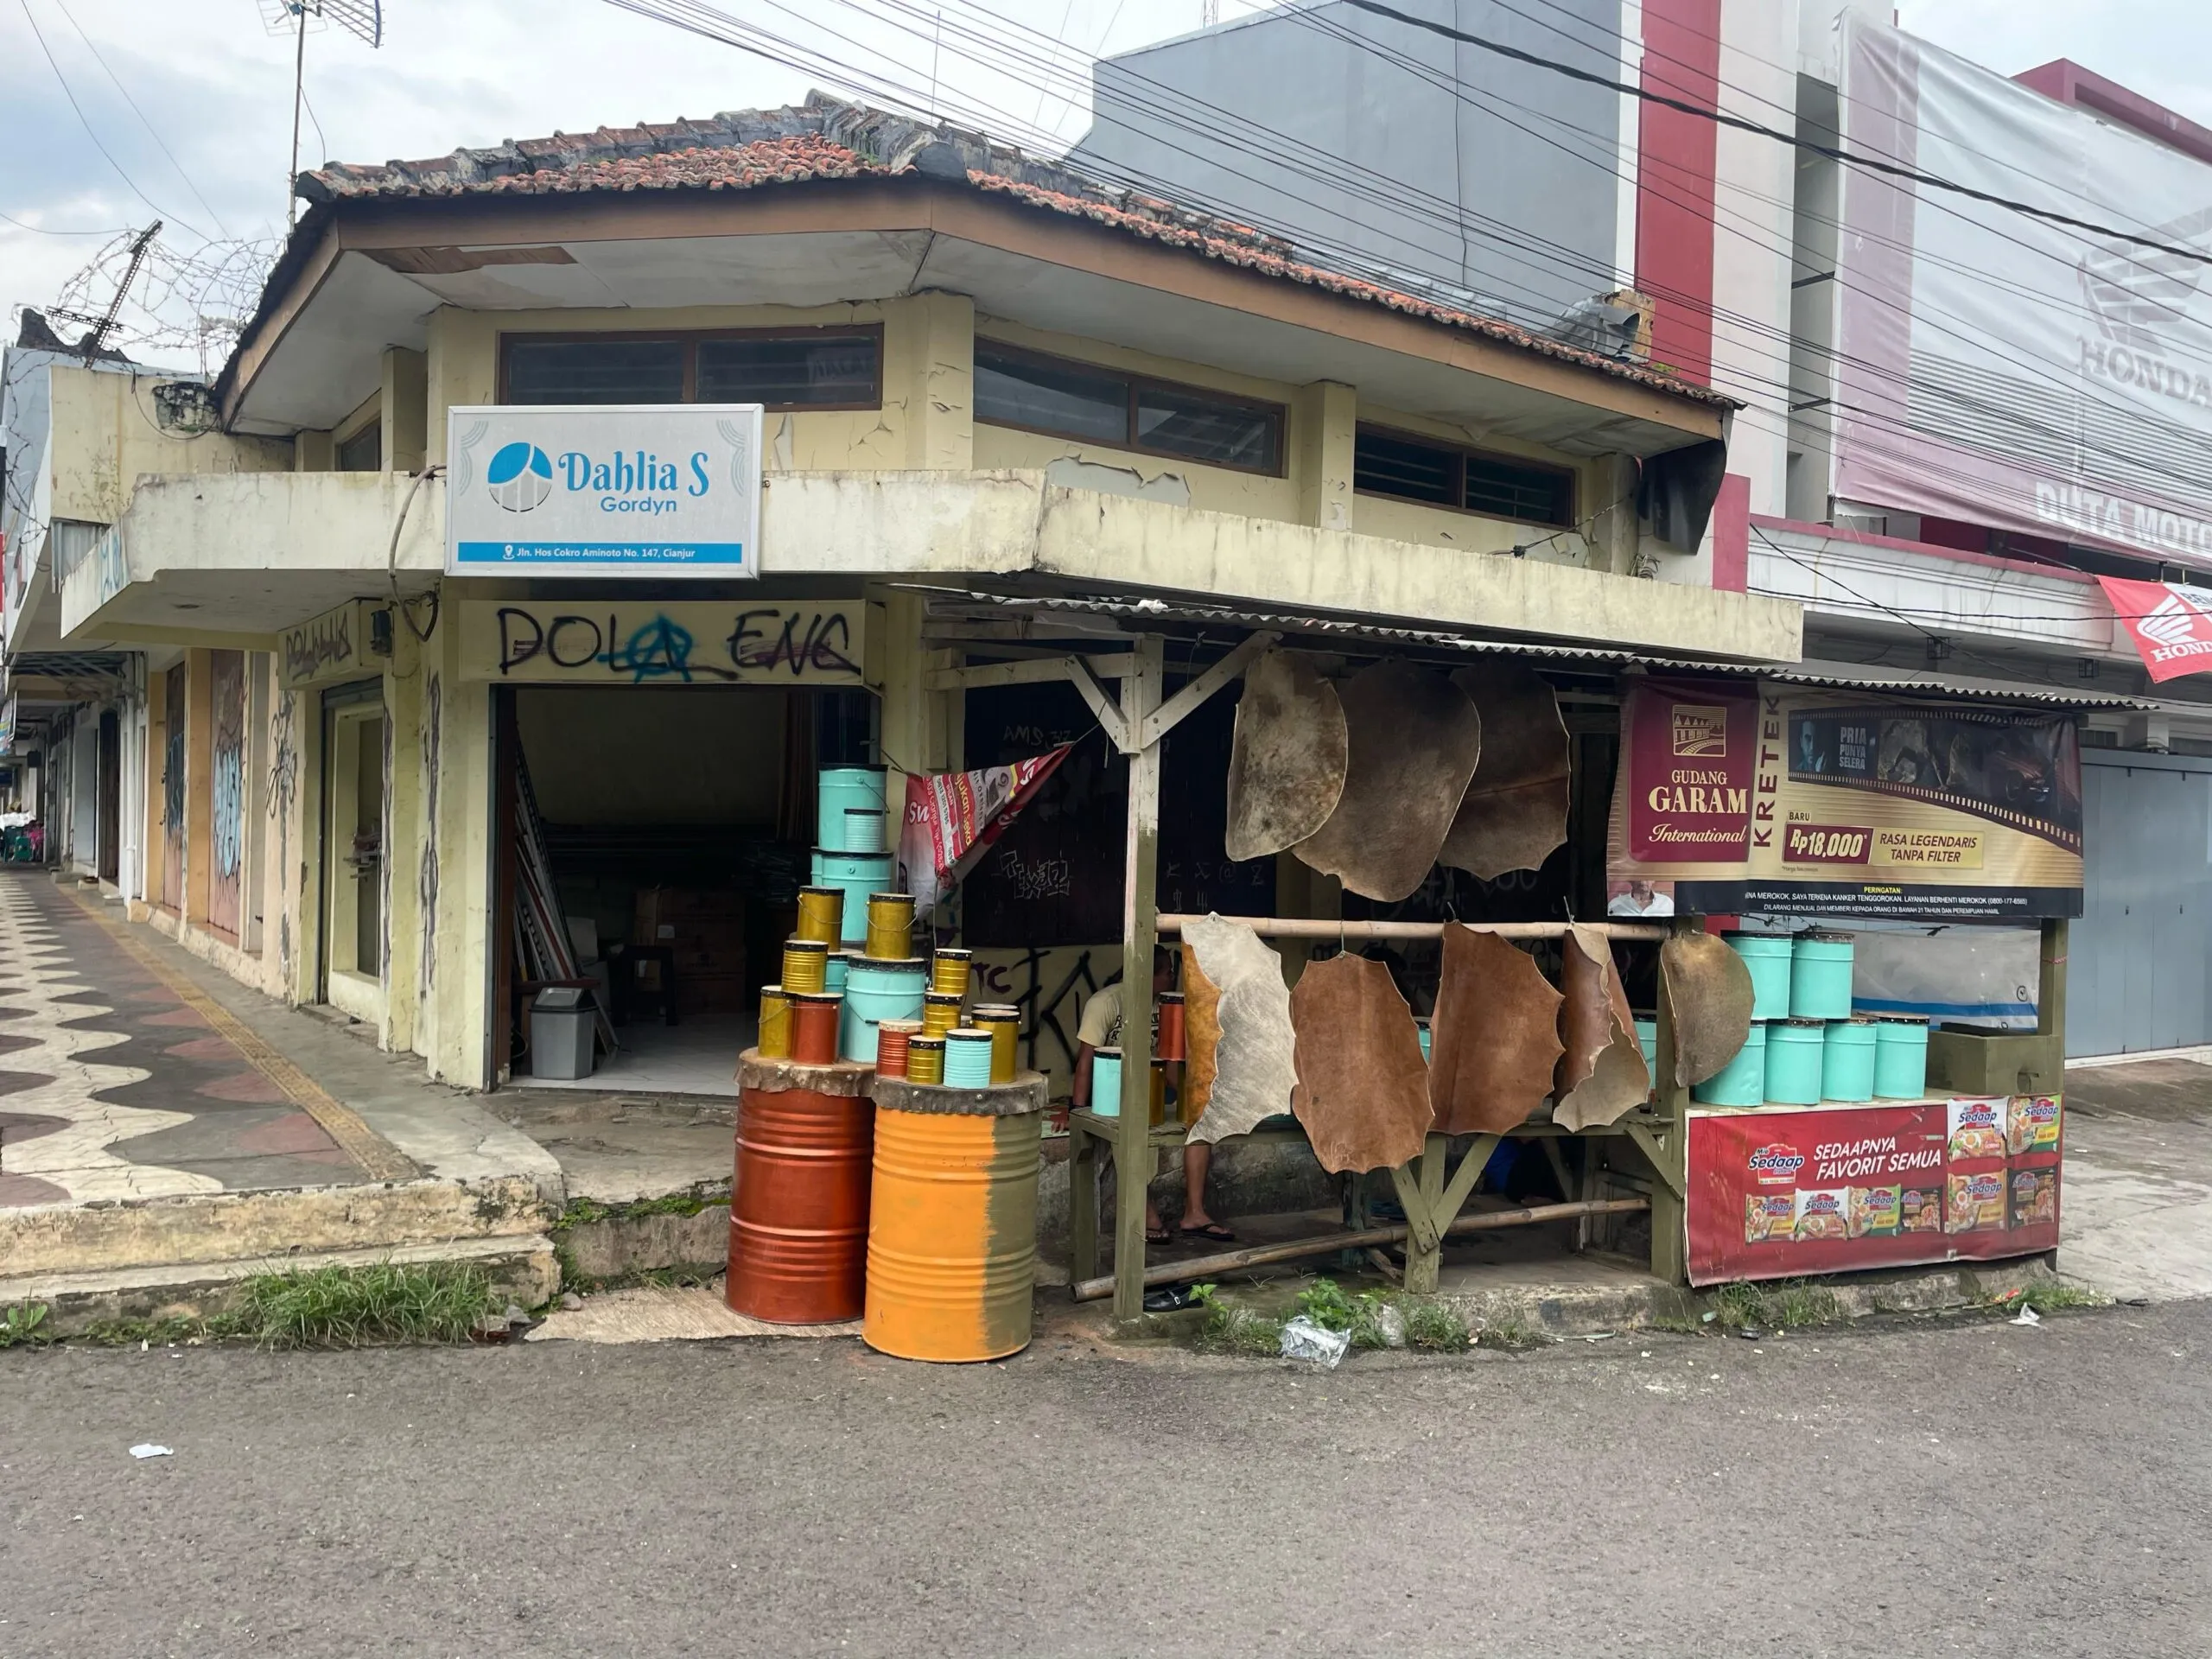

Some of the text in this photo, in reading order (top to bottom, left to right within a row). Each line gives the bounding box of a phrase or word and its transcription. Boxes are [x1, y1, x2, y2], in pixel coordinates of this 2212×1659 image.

[558, 450, 709, 497] Dahlia S
[601, 497, 677, 516] Gordyn
[2036, 481, 2121, 537] DUTA
[517, 548, 696, 560] Jln. Hos Cokro Aminoto No. 147, Cianjur
[1840, 727, 1866, 744] PRIA
[1840, 744, 1866, 758] PUNYA
[1753, 694, 1780, 848] KRETEK
[1839, 757, 1866, 770] SELERA
[1671, 769, 1728, 785] GUDANG
[1648, 785, 1748, 814] GARAM
[1789, 811, 1810, 822] BARU
[1649, 823, 1747, 843] International
[1880, 834, 1977, 849] RASA LEGENDARIS
[1891, 849, 1961, 863] TANPA FILTER
[1958, 1109, 1998, 1123] Sedaap
[2024, 1105, 2059, 1116] Sedaap
[1813, 1137, 1897, 1161] SEDAAPNYA
[1748, 1154, 1805, 1171] Sedaap
[1816, 1149, 1942, 1181] FAVORIT SEMUA
[1966, 1182, 2004, 1194] Sedaap
[1762, 1202, 1795, 1211] Sedaap
[1804, 1198, 1840, 1211] Sedaap
[1863, 1194, 1897, 1205] Sedaap
